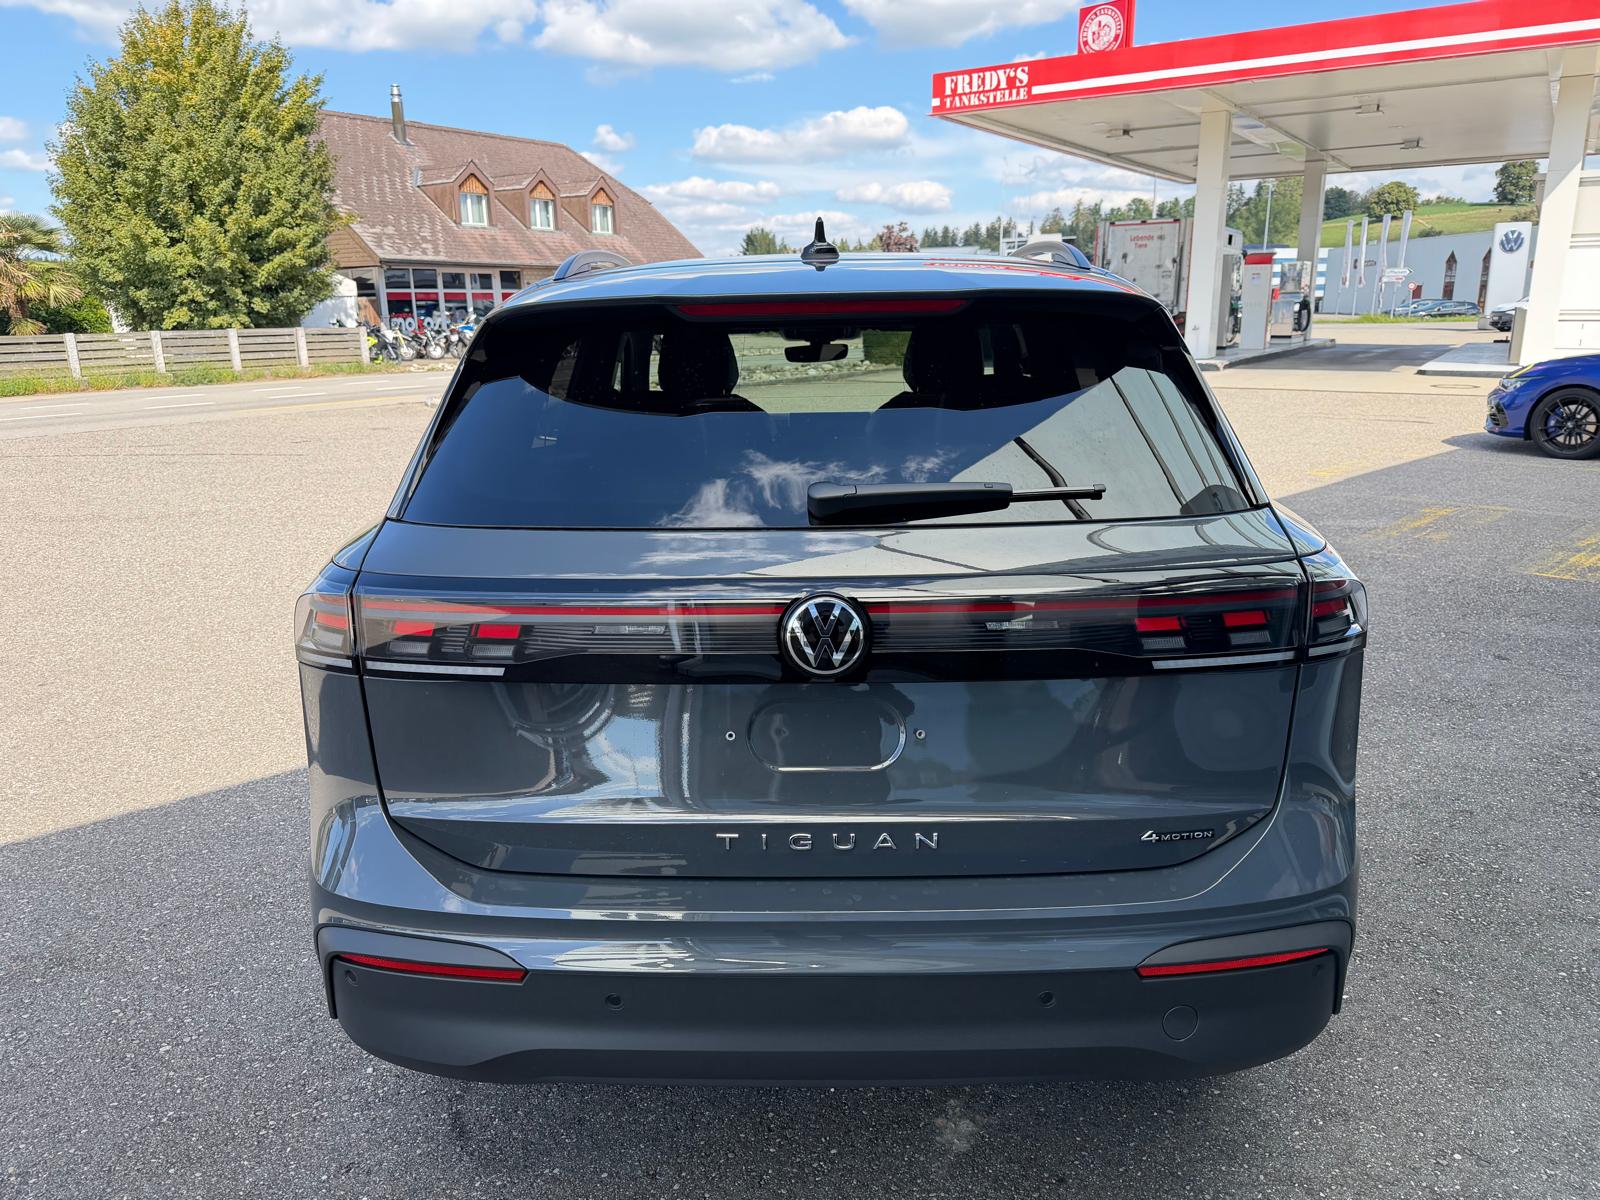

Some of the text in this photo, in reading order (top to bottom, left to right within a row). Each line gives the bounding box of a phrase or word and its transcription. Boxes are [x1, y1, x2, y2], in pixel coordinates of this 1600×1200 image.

[944, 66, 1029, 96] FREDY'S
[944, 87, 1028, 109] TANKSTELLE
[1500, 229, 1525, 254] VW
[784, 594, 864, 674] VW
[715, 832, 940, 851] TIGUAN
[1140, 830, 1213, 843] 4MOTION
